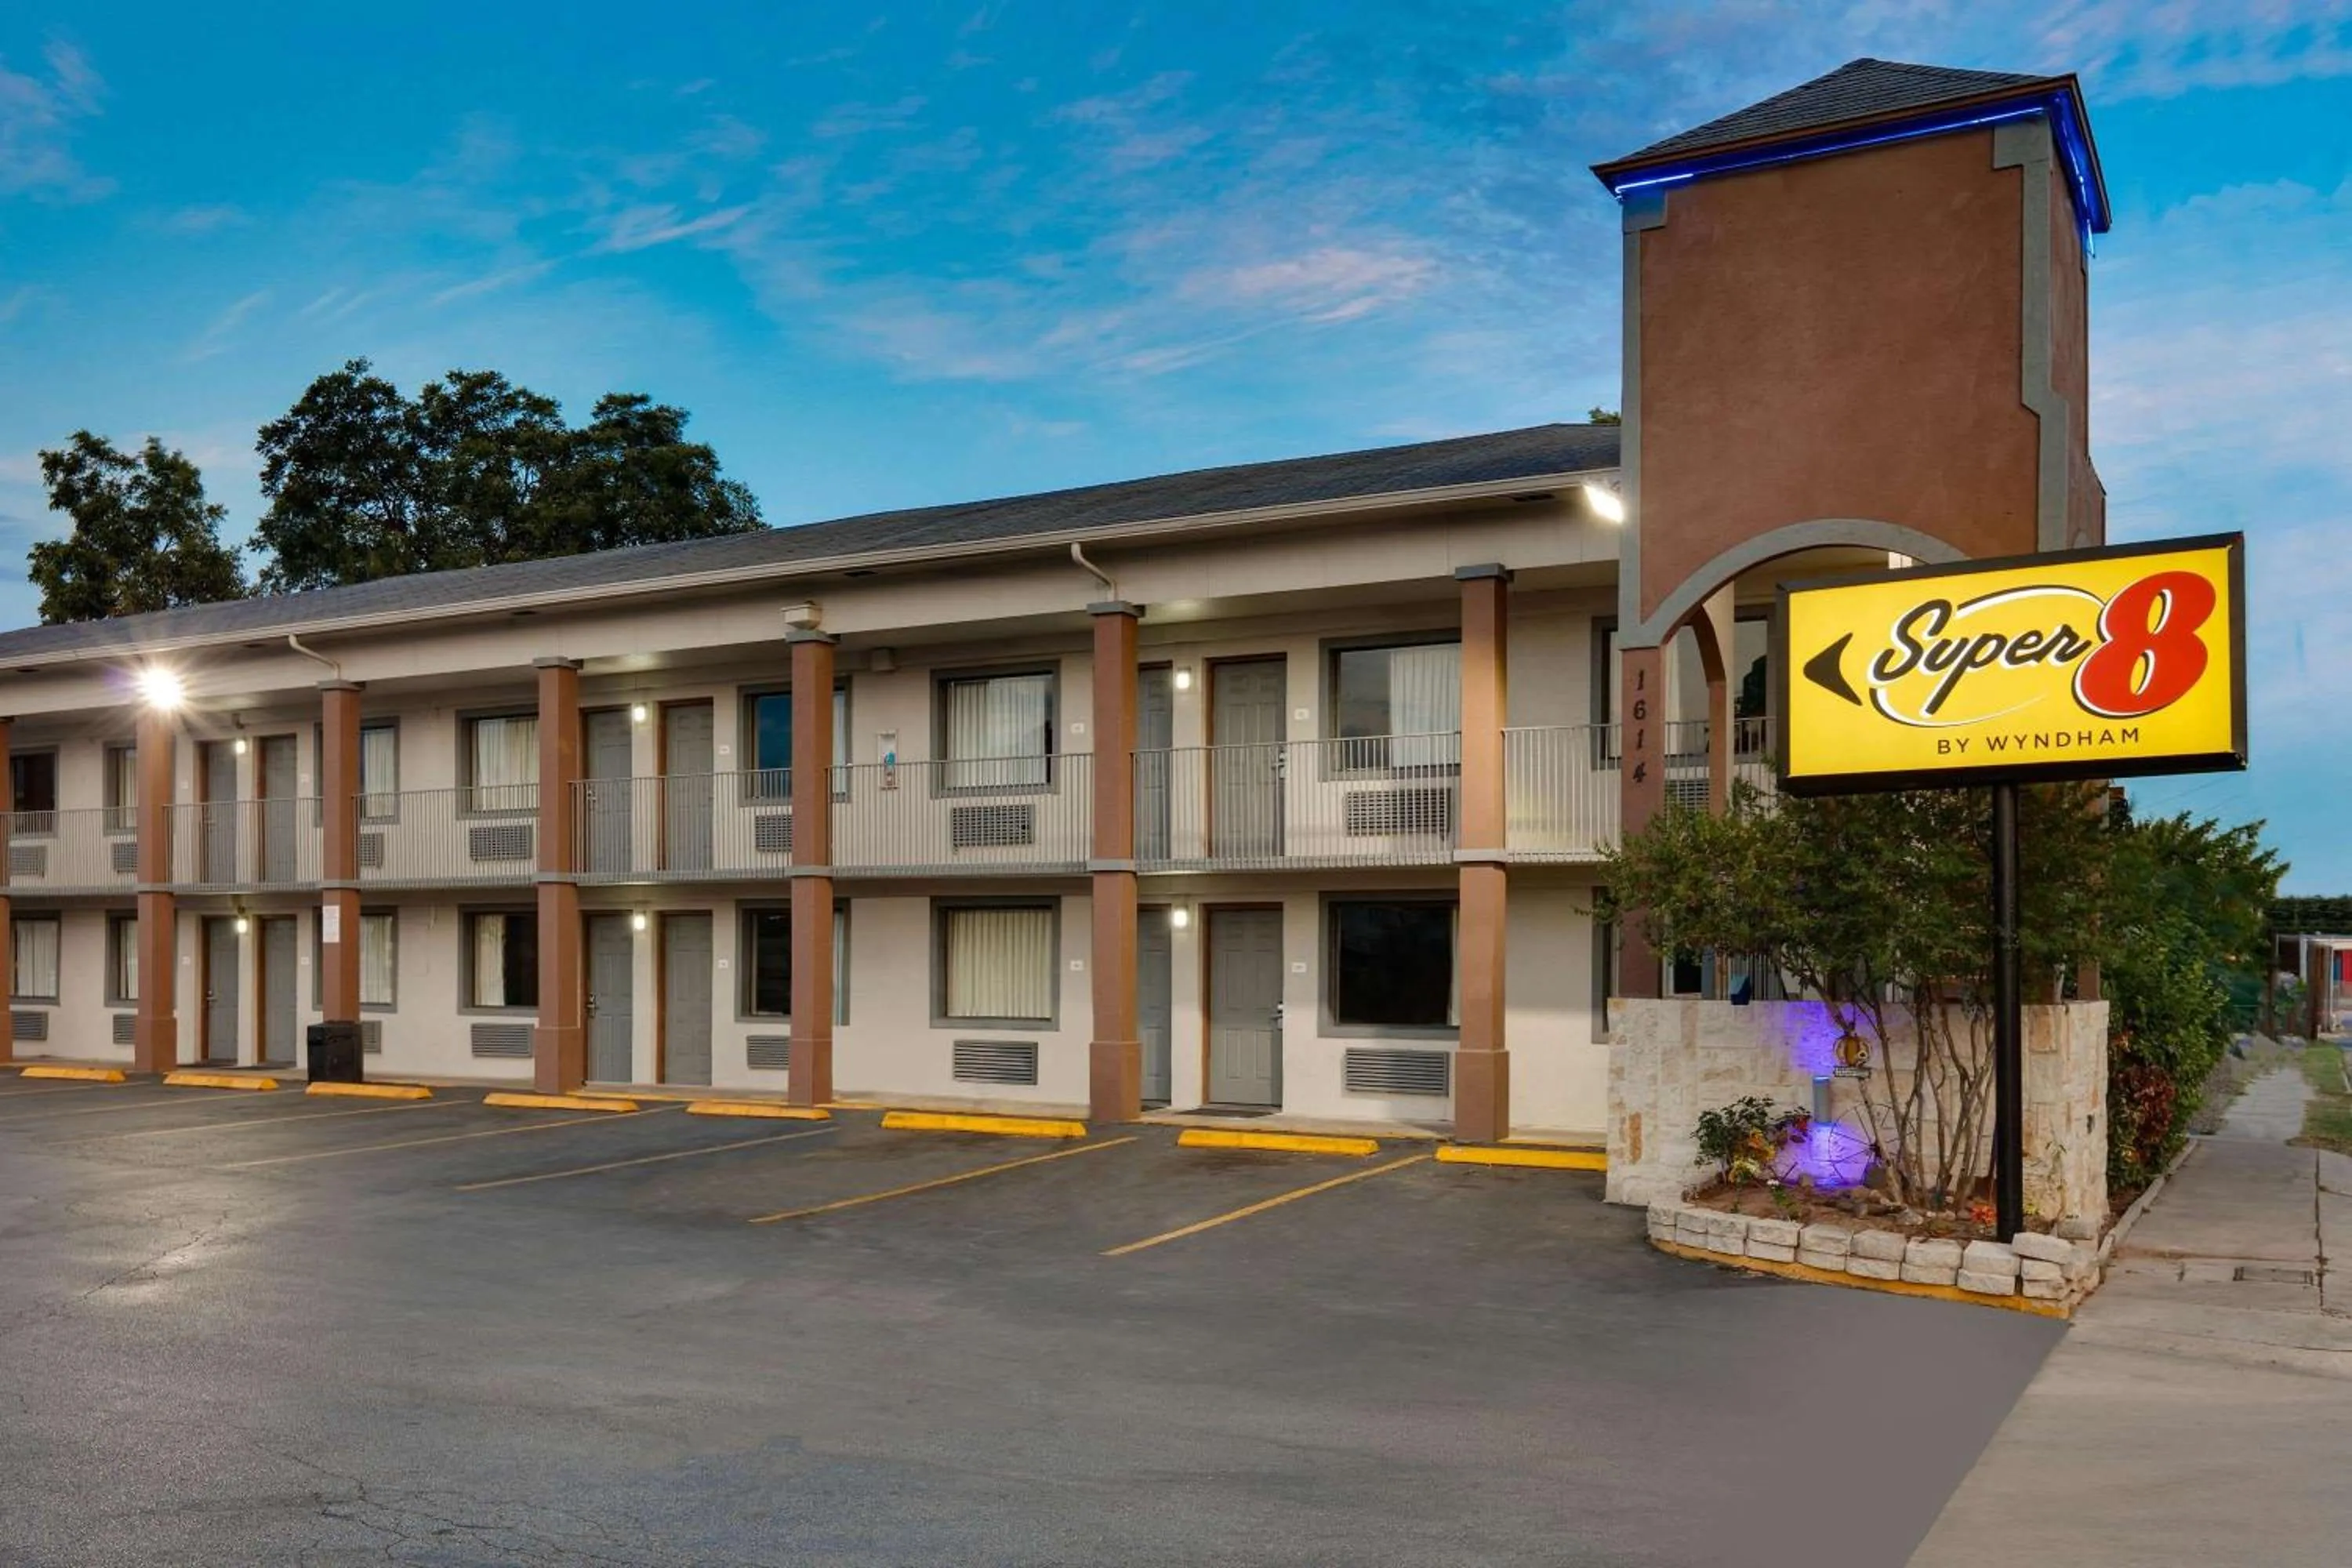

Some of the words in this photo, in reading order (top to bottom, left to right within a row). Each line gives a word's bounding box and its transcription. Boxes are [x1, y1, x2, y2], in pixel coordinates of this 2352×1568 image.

[1868, 598, 2092, 717] Super
[2072, 570, 2217, 719] 8
[1633, 670, 1646, 782] 1614
[1936, 738, 1970, 755] BY
[1986, 727, 2140, 752] WYNDHAM
